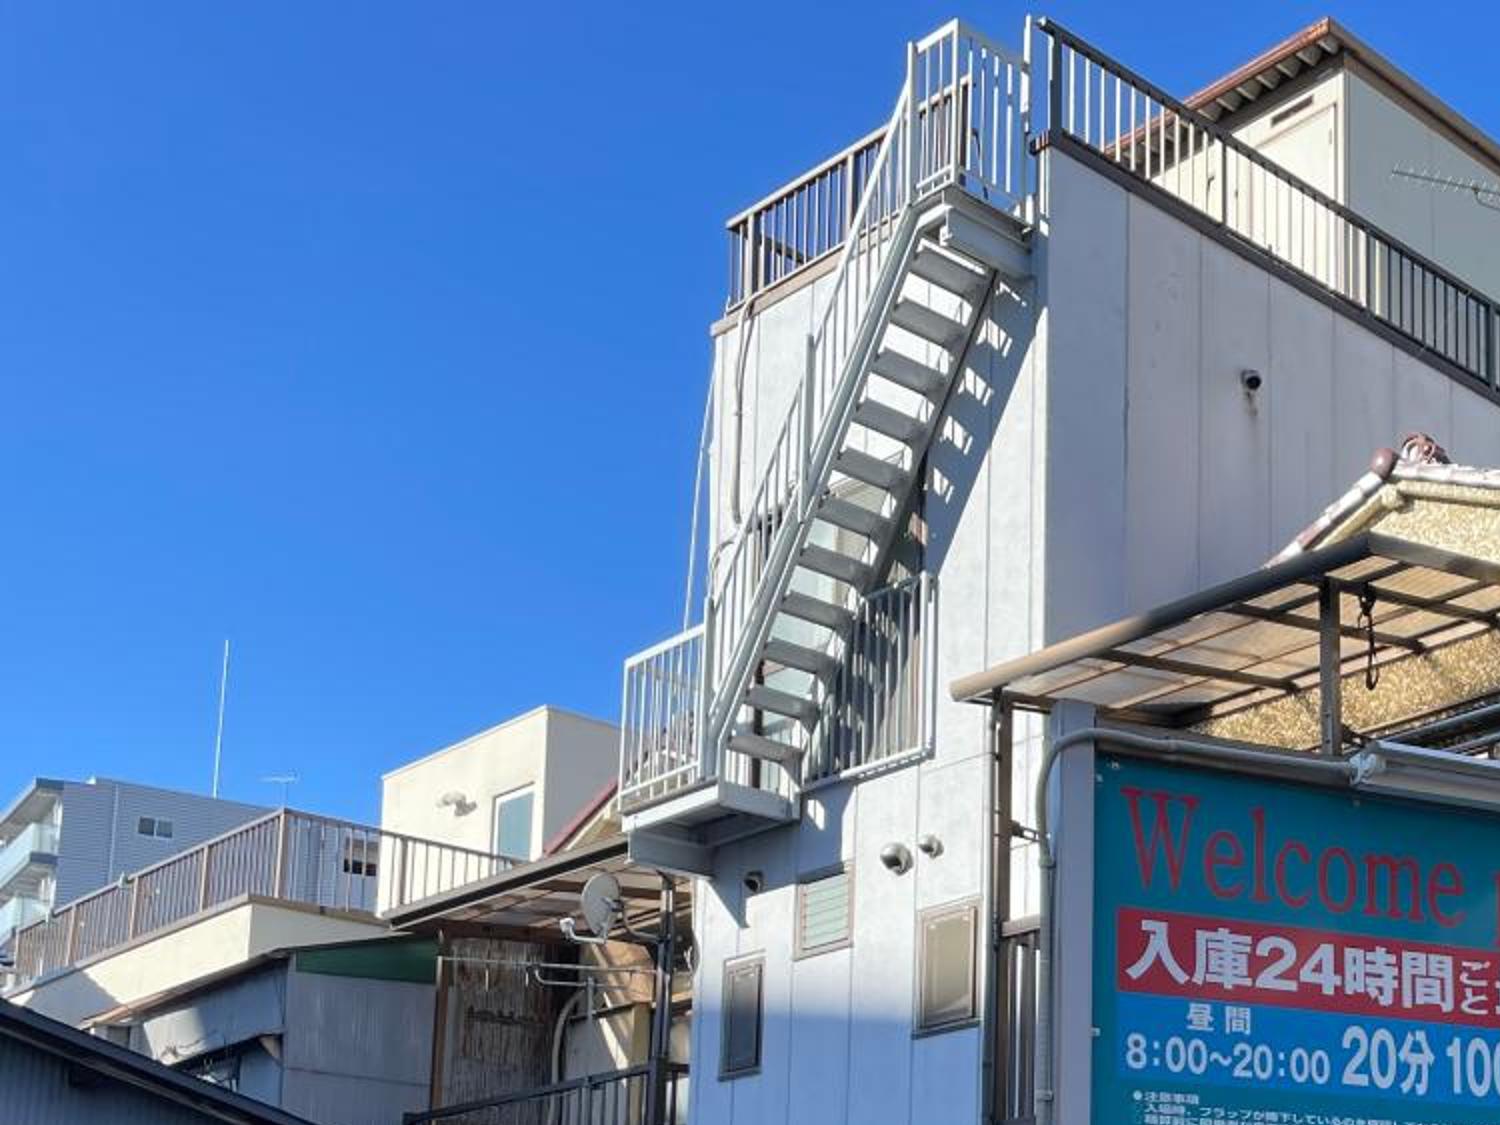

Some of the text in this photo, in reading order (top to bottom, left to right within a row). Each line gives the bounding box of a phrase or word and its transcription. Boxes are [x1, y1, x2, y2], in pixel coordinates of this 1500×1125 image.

[1120, 787, 1466, 928] Welcome
[1187, 1002, 1252, 1035] 昼間
[1341, 1025, 1436, 1096] 20分
